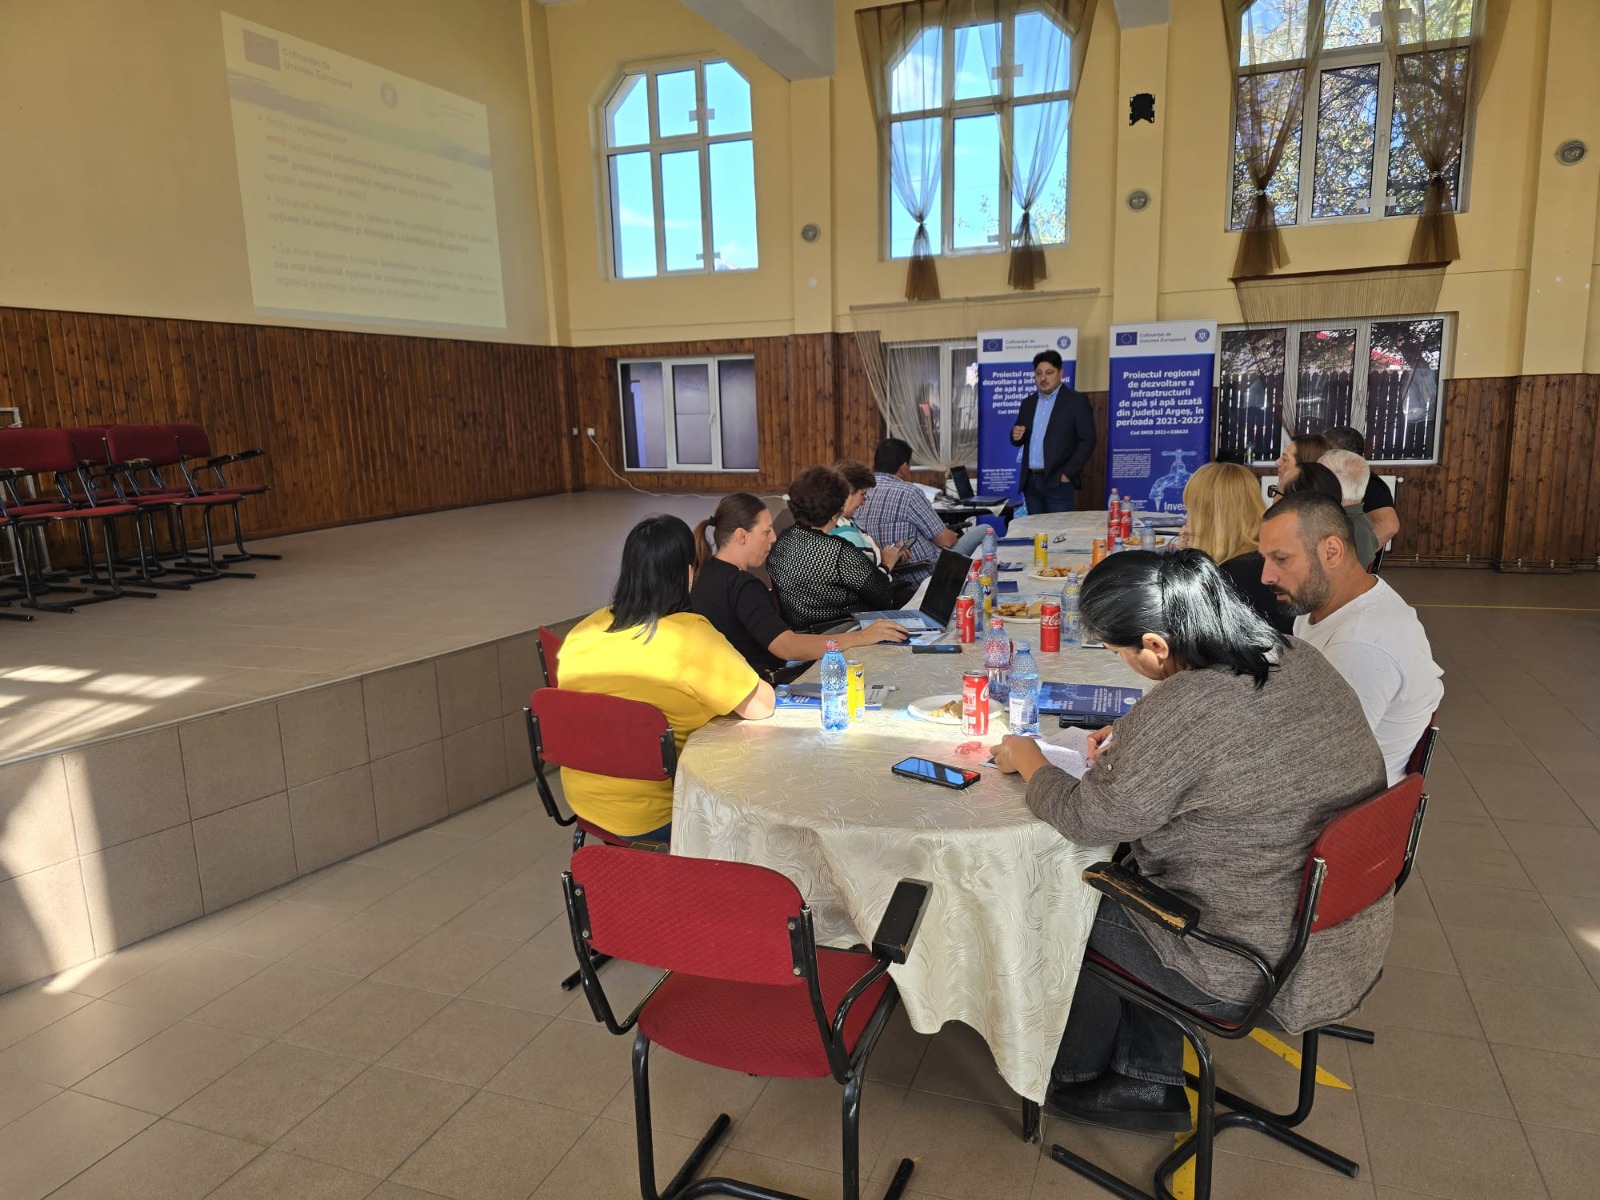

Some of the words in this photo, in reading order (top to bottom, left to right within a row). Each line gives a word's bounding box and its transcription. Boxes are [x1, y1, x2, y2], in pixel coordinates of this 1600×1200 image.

[1123, 370, 1162, 379] Proiectul
[1164, 369, 1200, 378] regional
[1130, 388, 1191, 397] infrastructurii
[1132, 399, 1147, 407] apă
[1150, 399, 1157, 407] și
[1159, 398, 1175, 407] apă
[1132, 408, 1163, 417] județul
[1165, 408, 1193, 416] Argeș,
[1116, 418, 1154, 427] perioada
[1156, 416, 1204, 425] 2021-2027
